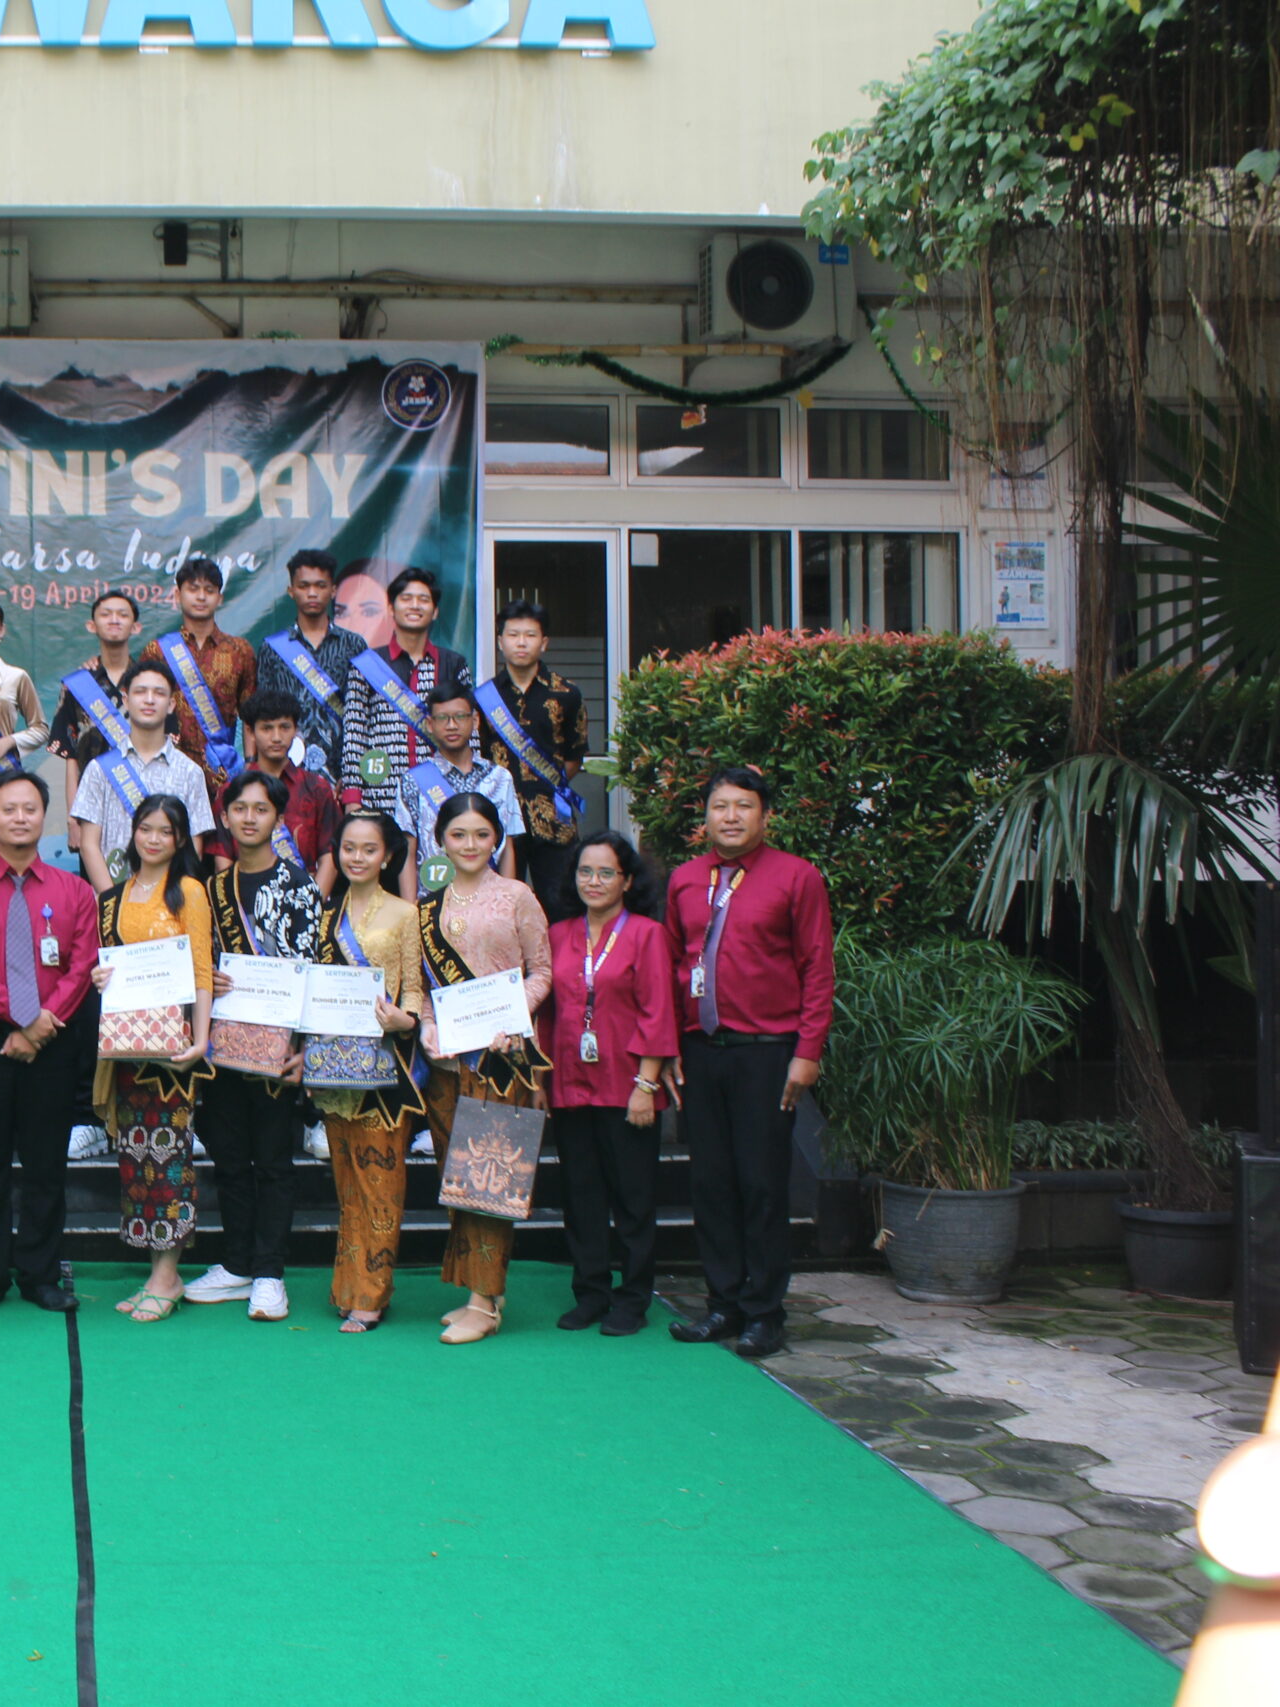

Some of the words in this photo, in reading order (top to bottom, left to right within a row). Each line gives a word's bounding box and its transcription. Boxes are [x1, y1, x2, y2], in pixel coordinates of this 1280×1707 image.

[204, 451, 368, 520] DAY
[366, 757, 385, 775] 15
[428, 864, 448, 882] 17
